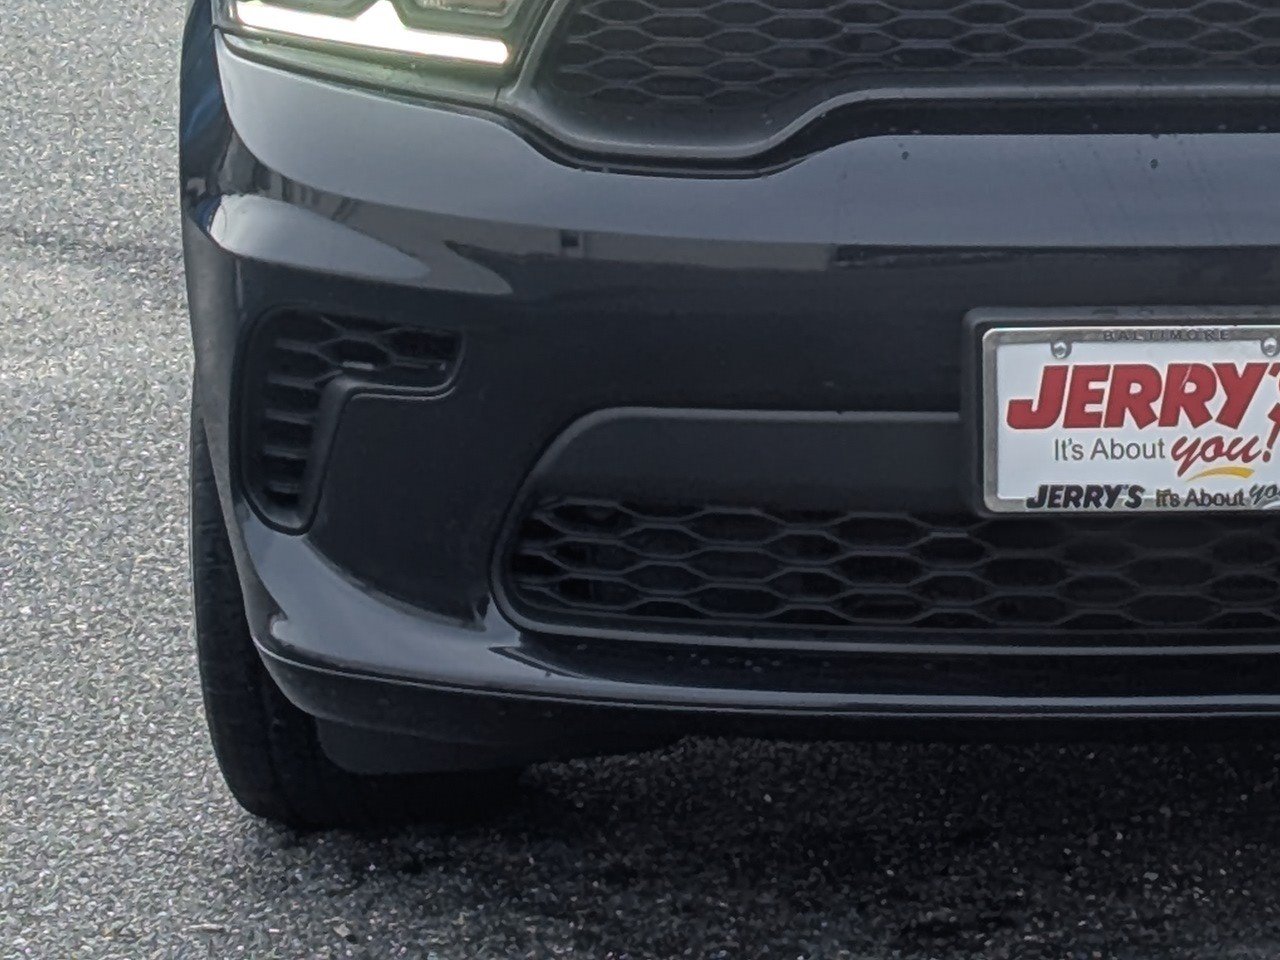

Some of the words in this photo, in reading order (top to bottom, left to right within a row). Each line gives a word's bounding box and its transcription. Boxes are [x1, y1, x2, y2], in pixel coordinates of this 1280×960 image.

[1054, 438, 1084, 461] It's
[1090, 438, 1166, 461] About
[1026, 484, 1146, 509] JERRY'S
[1184, 487, 1246, 508] About
